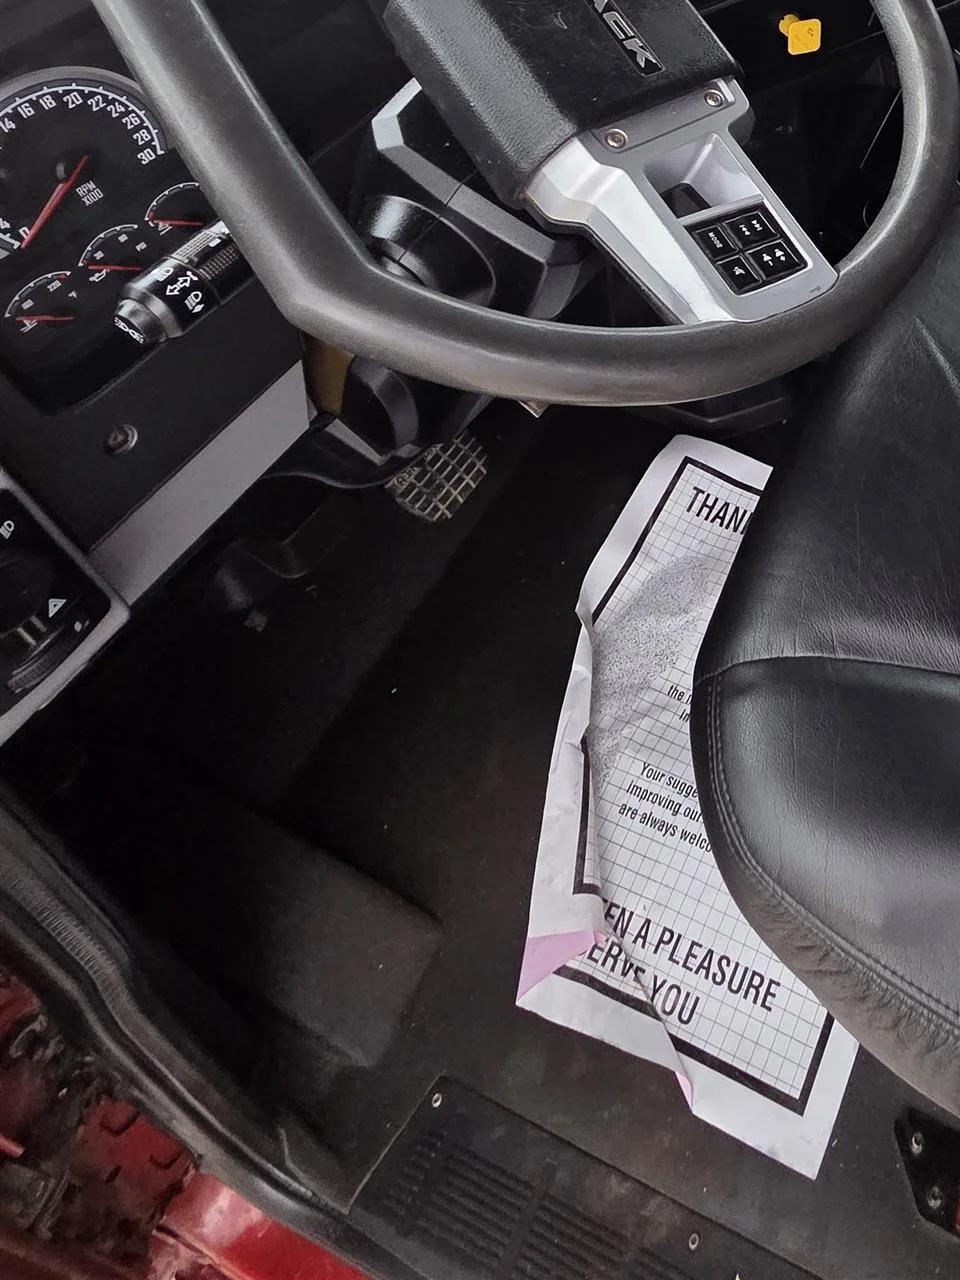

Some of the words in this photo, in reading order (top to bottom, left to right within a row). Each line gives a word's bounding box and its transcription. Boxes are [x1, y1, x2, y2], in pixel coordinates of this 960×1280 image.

[39, 95, 57, 110] 18
[63, 91, 83, 109] 20
[87, 95, 107, 112] 22
[17, 102, 35, 119] 16
[106, 102, 125, 118] 24
[0, 117, 16, 133] 14
[122, 113, 141, 130] 26
[133, 129, 151, 146] 28
[137, 148, 156, 165] 30
[76, 180, 97, 197] RPM
[81, 188, 104, 206] X100
[708, 231, 723, 249] MODE
[641, 762, 665, 782] Your
[626, 780, 681, 816] improving
[618, 803, 638, 820] are
[639, 812, 678, 837] always
[632, 918, 652, 950] A
[653, 926, 781, 1012] PLEASURE
[650, 974, 700, 1025] YOU
